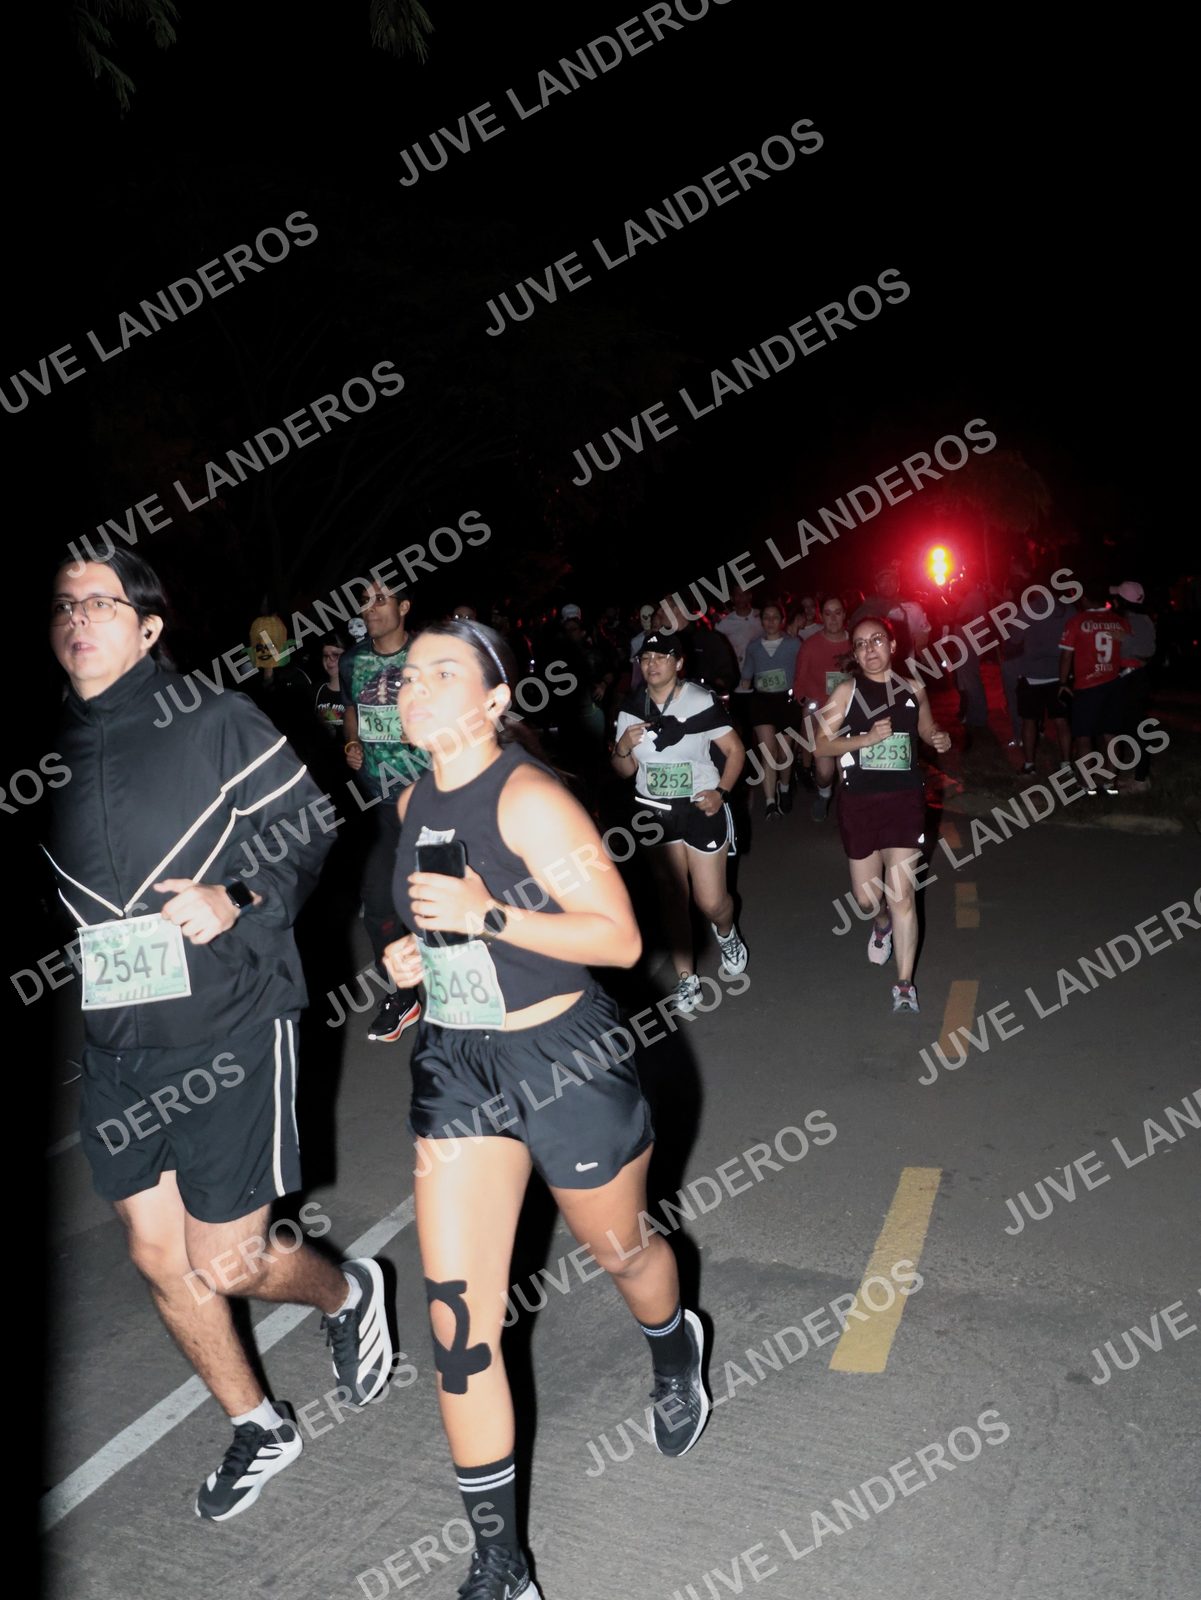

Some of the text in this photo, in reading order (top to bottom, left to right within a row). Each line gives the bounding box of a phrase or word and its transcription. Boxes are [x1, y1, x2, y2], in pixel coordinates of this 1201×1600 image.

[1094, 631, 1113, 664] 9
[762, 676, 780, 688] 853
[866, 745, 908, 761] 3253
[650, 772, 689, 789] 3252
[94, 942, 169, 986] 2547
